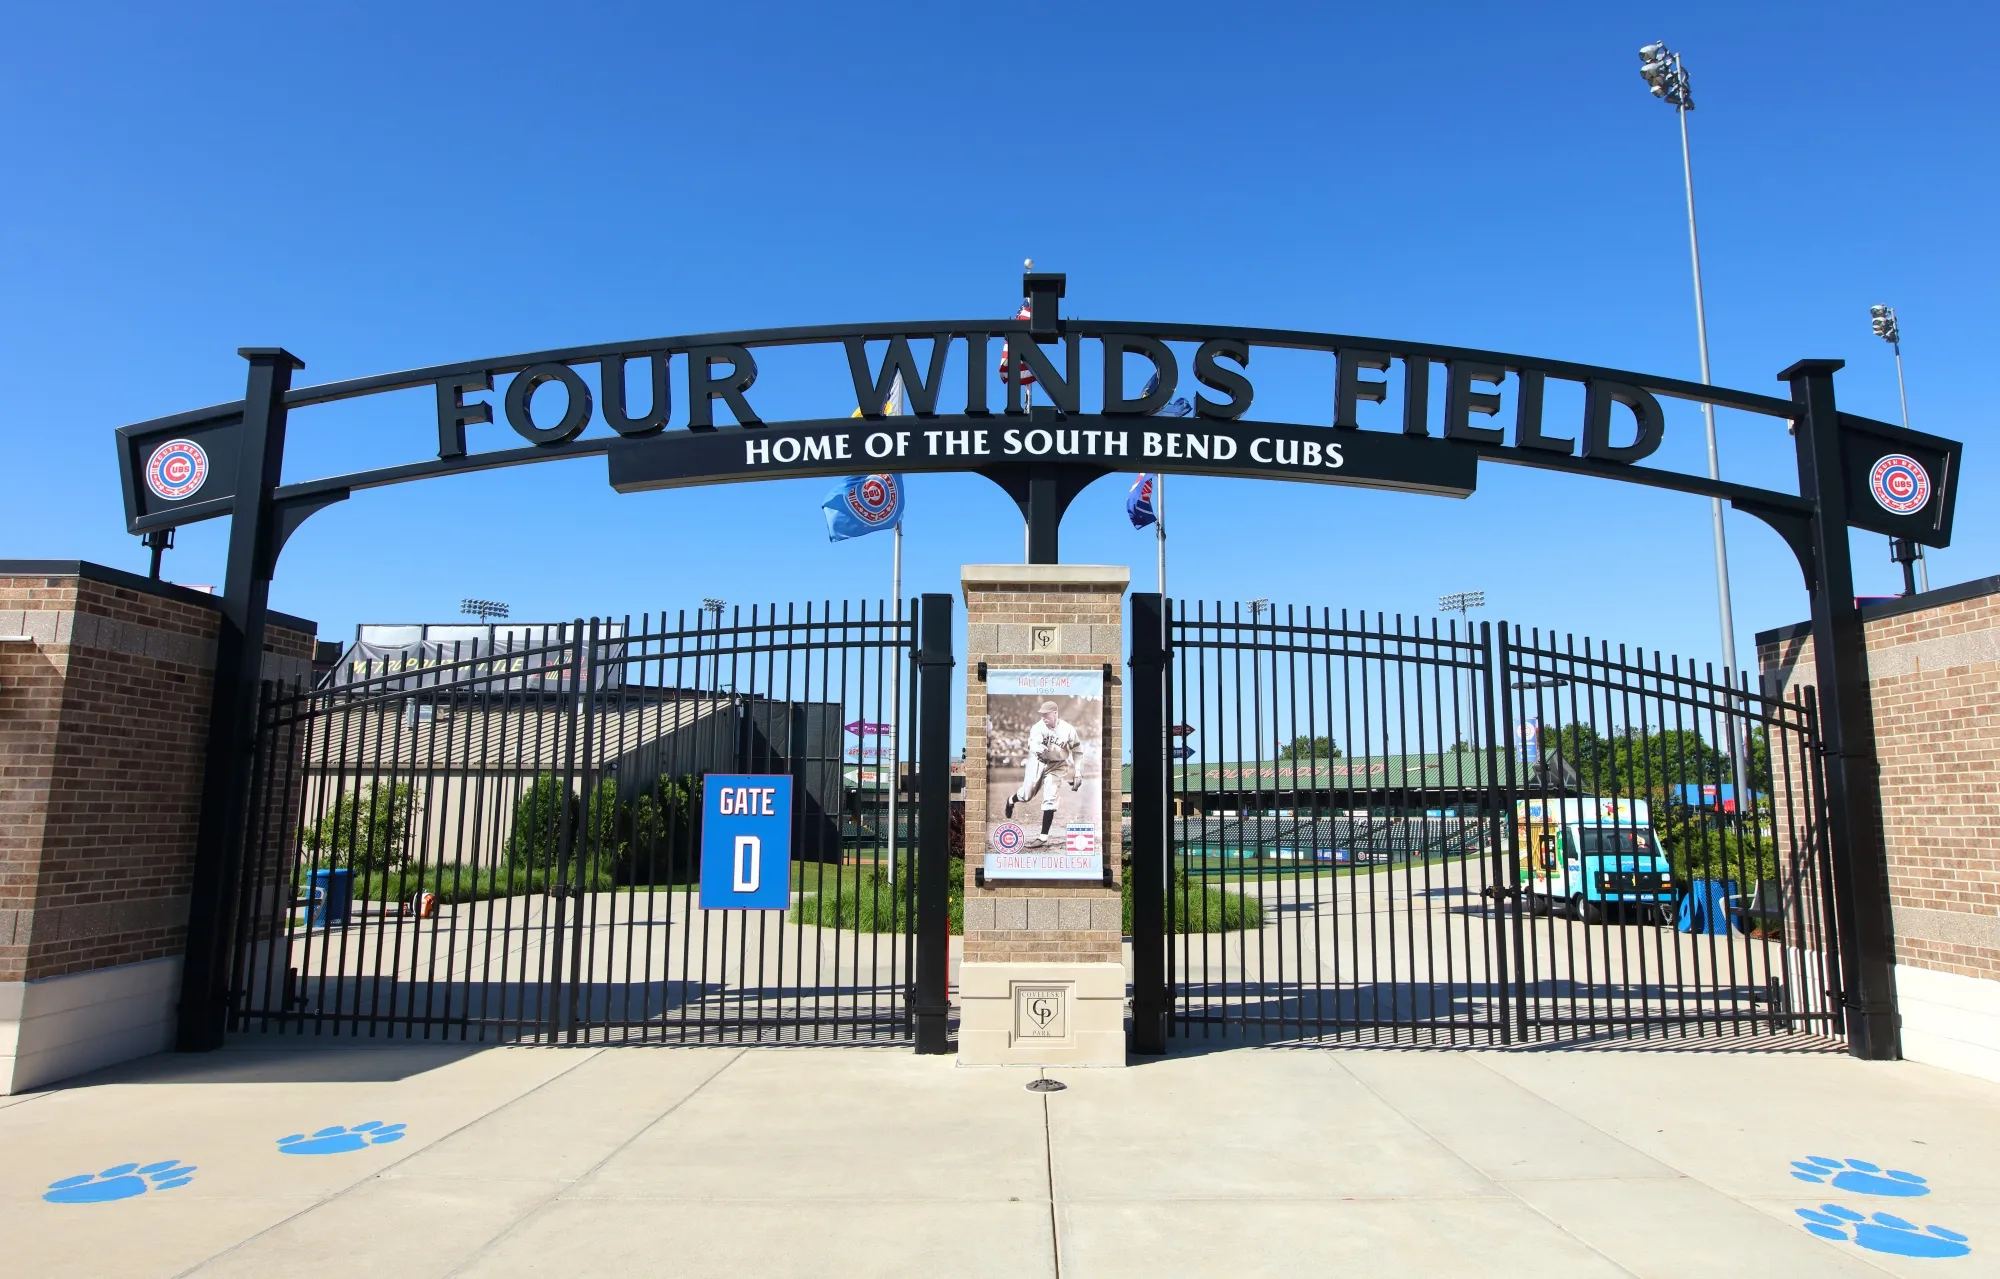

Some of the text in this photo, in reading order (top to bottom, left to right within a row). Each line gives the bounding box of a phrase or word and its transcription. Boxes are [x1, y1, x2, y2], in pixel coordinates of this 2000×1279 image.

[436, 331, 1664, 464] FOUR WINDS FIELD
[153, 445, 203, 467] SOUTH BEND
[746, 430, 1344, 467] HOME OF THE SOUTH BEND CUBS
[1875, 459, 1923, 480] SOUTH BEND
[346, 657, 476, 674] METROPOLITN
[1018, 677, 1071, 687] HALL OF FAME
[720, 787, 776, 815] GATE
[733, 835, 761, 893] D
[996, 856, 1092, 869] STANLEY COVELESKI
